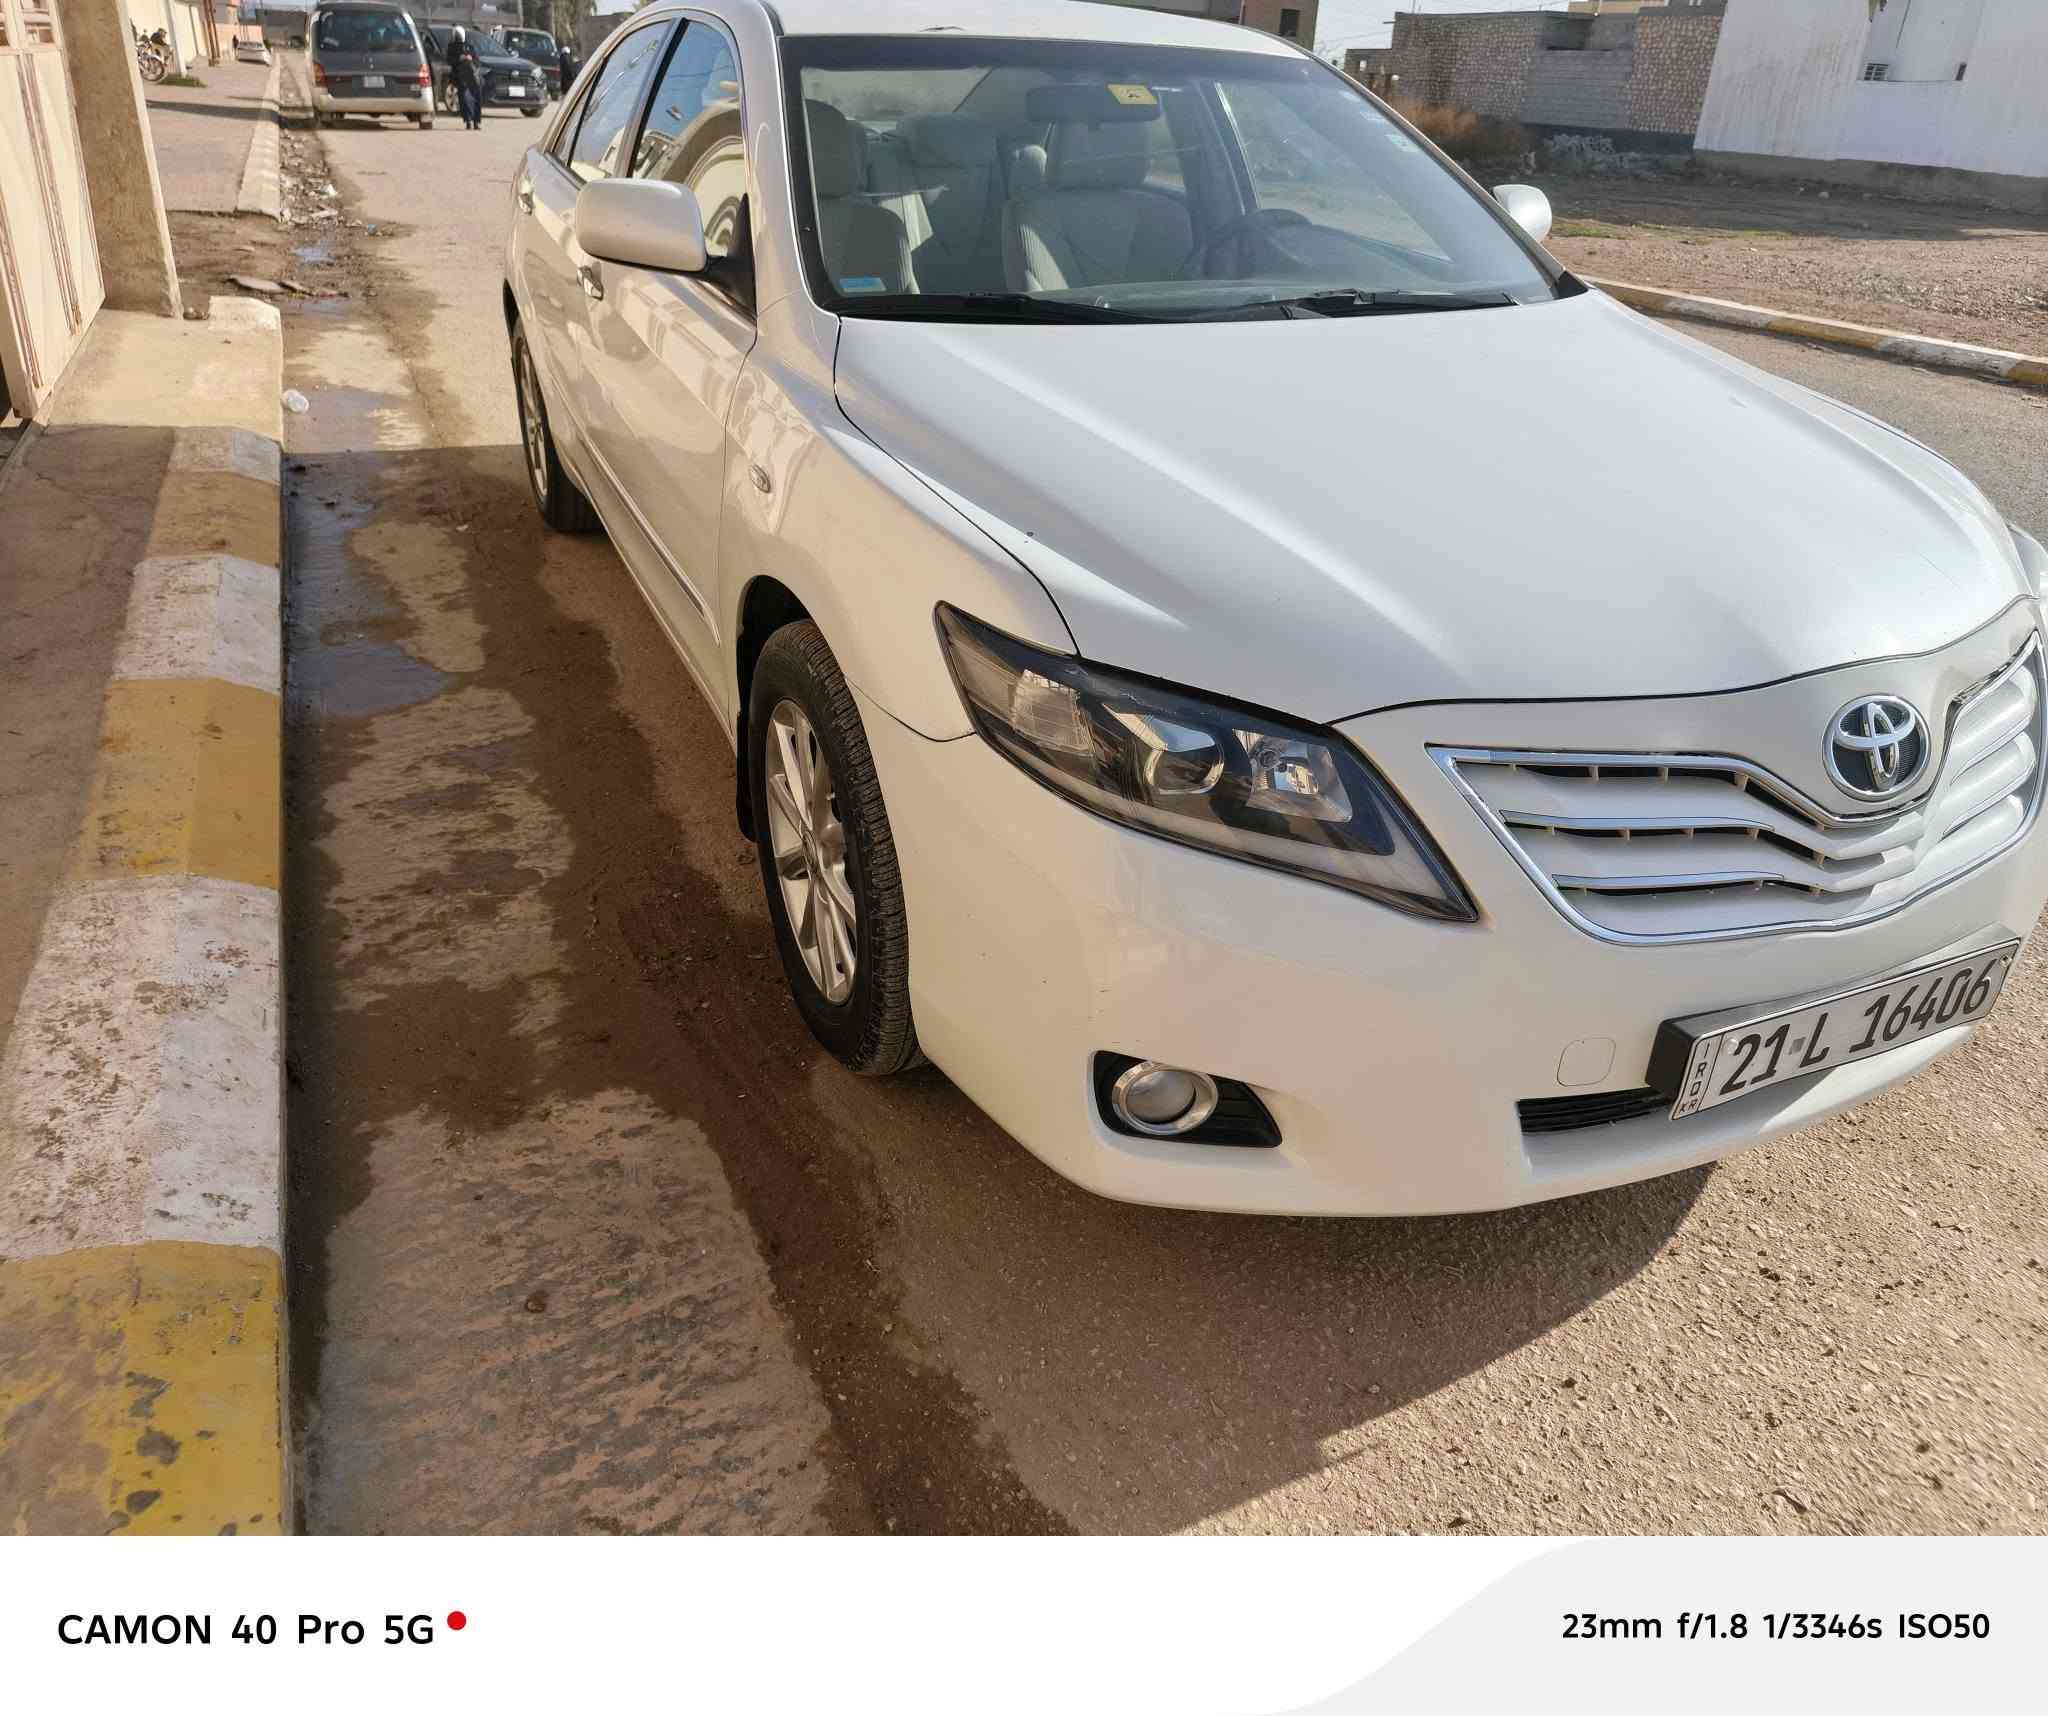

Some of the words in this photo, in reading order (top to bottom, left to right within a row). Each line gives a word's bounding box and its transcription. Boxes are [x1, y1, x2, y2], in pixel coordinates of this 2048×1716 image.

[1719, 1023, 1791, 1096] 21
[1799, 1012, 1831, 1069] L
[1849, 958, 1998, 1054] 16406
